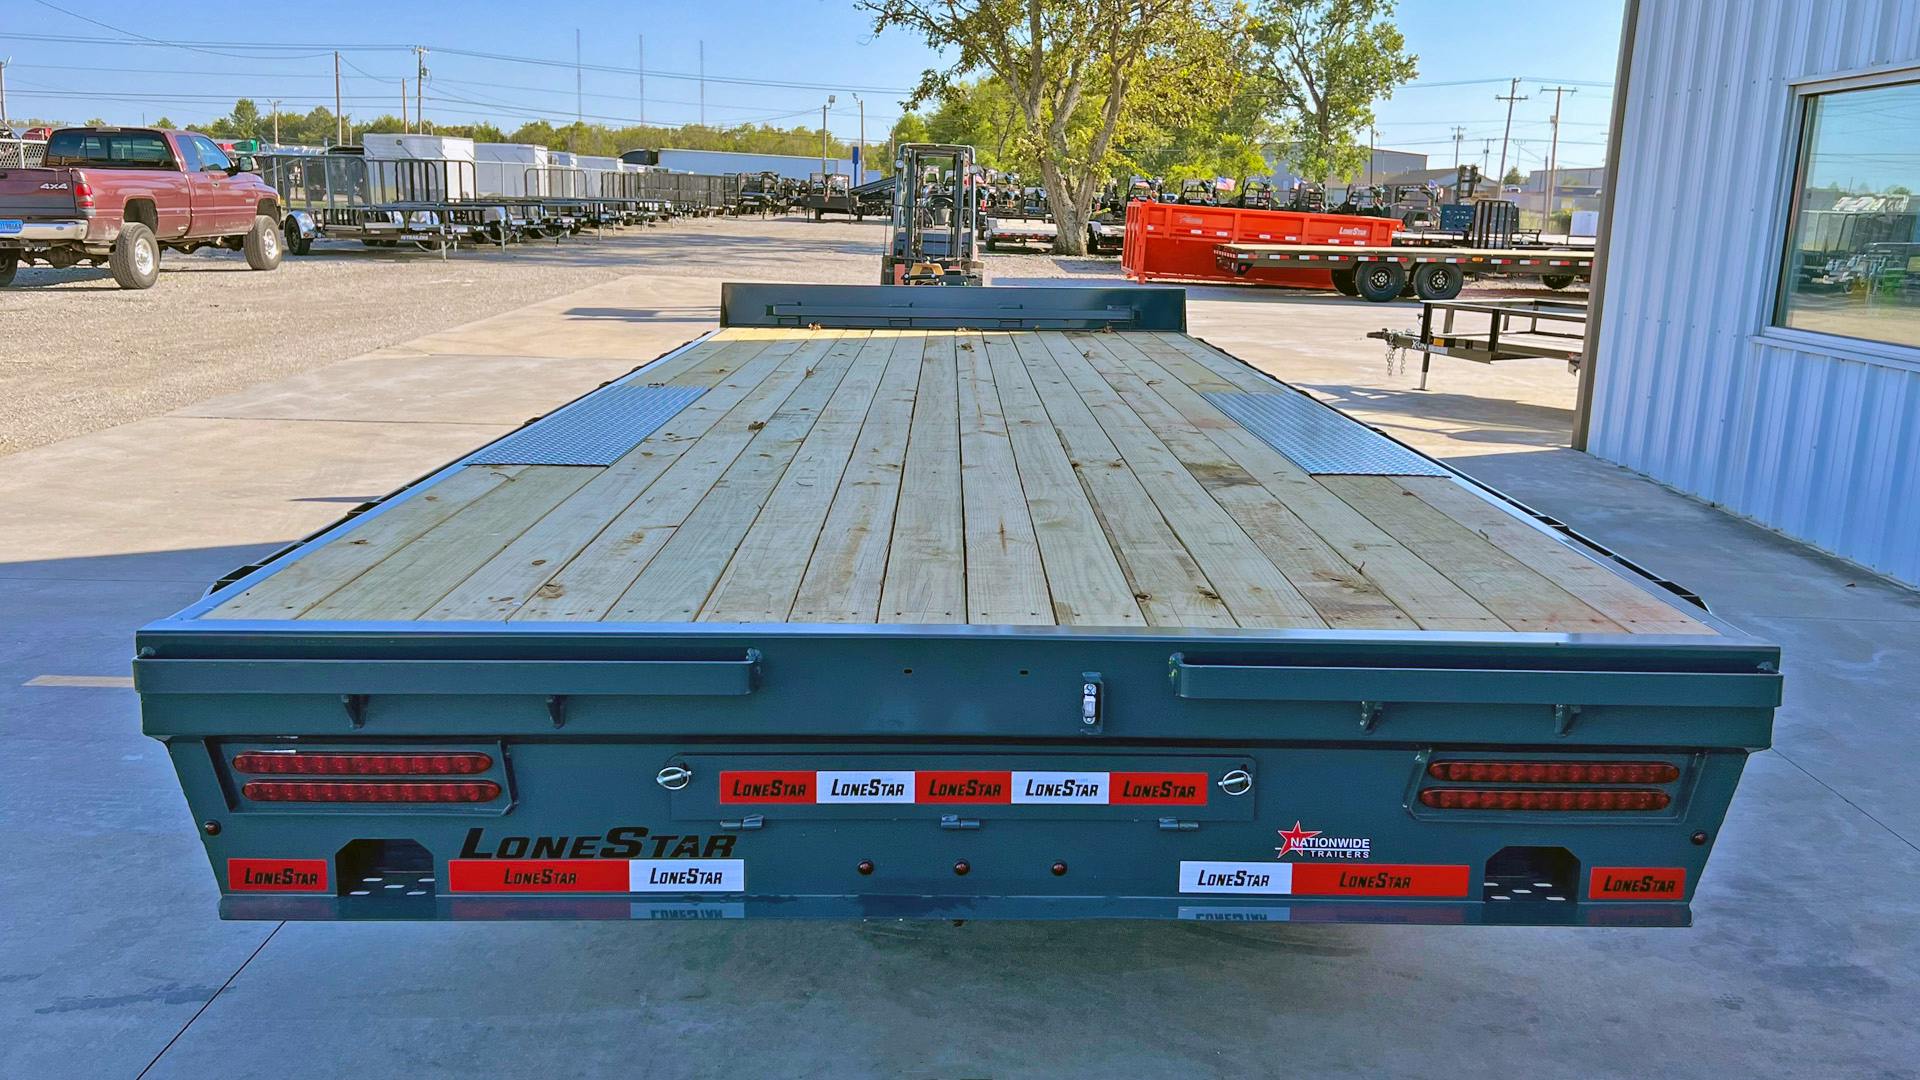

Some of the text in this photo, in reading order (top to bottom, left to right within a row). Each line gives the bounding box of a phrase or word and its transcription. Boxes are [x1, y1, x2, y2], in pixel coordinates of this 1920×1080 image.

[733, 778, 1197, 798] LONESTAR LONESTAR LONESTAR LONESTAR LONESTAR
[459, 826, 738, 859] LONESTAR
[1290, 837, 1371, 849] NATIONWIDE
[1310, 850, 1370, 859] TRAILERS
[244, 867, 319, 885] LONESTAR
[503, 867, 723, 885] LONESTAR LONESTAR
[1197, 869, 1412, 889] LONESTAR LONESTAR
[1603, 875, 1676, 892] LONESTAR
